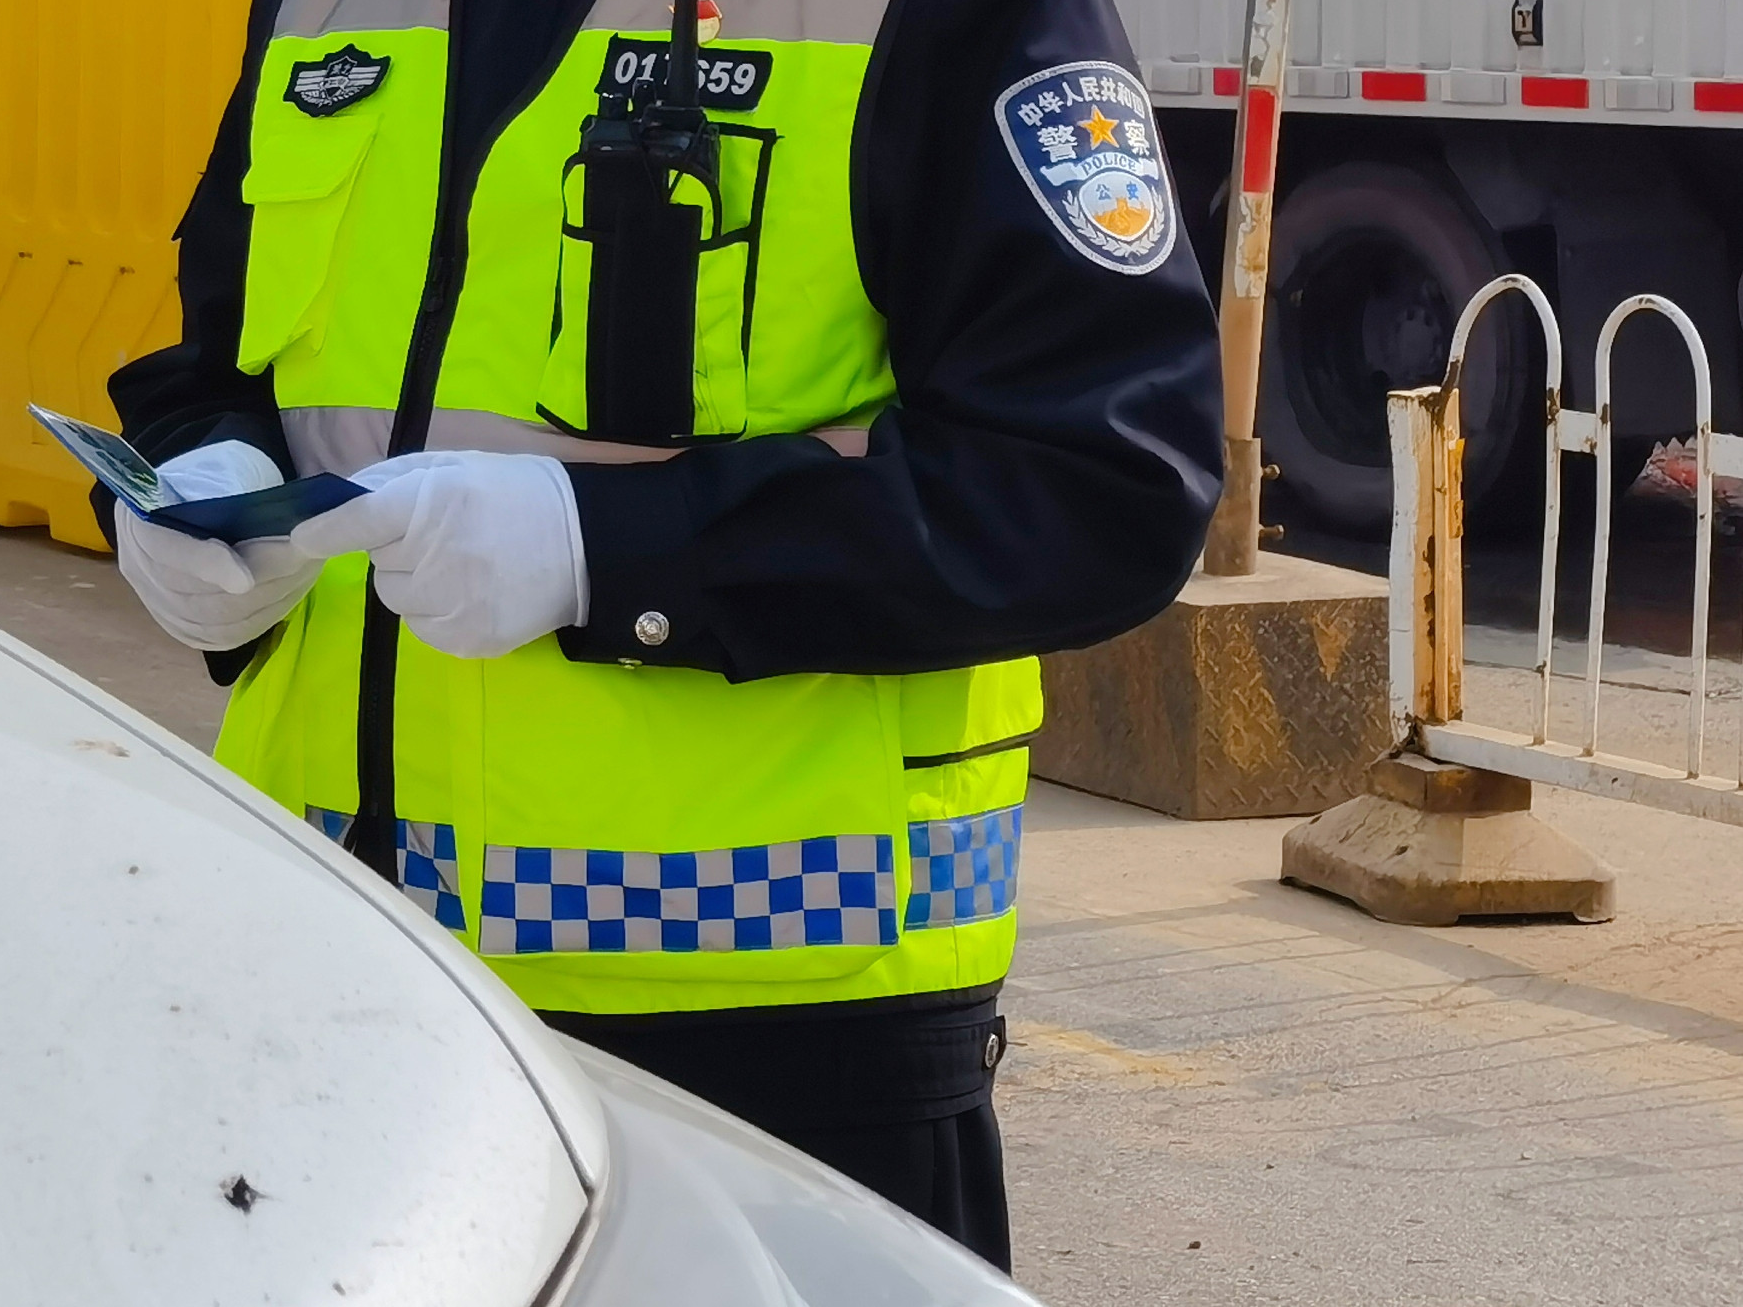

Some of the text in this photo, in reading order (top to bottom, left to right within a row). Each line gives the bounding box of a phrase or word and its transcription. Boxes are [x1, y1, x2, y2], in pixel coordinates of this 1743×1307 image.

[1017, 75, 1146, 128] 中华人民共和国
[1080, 153, 1138, 177] POLICE
